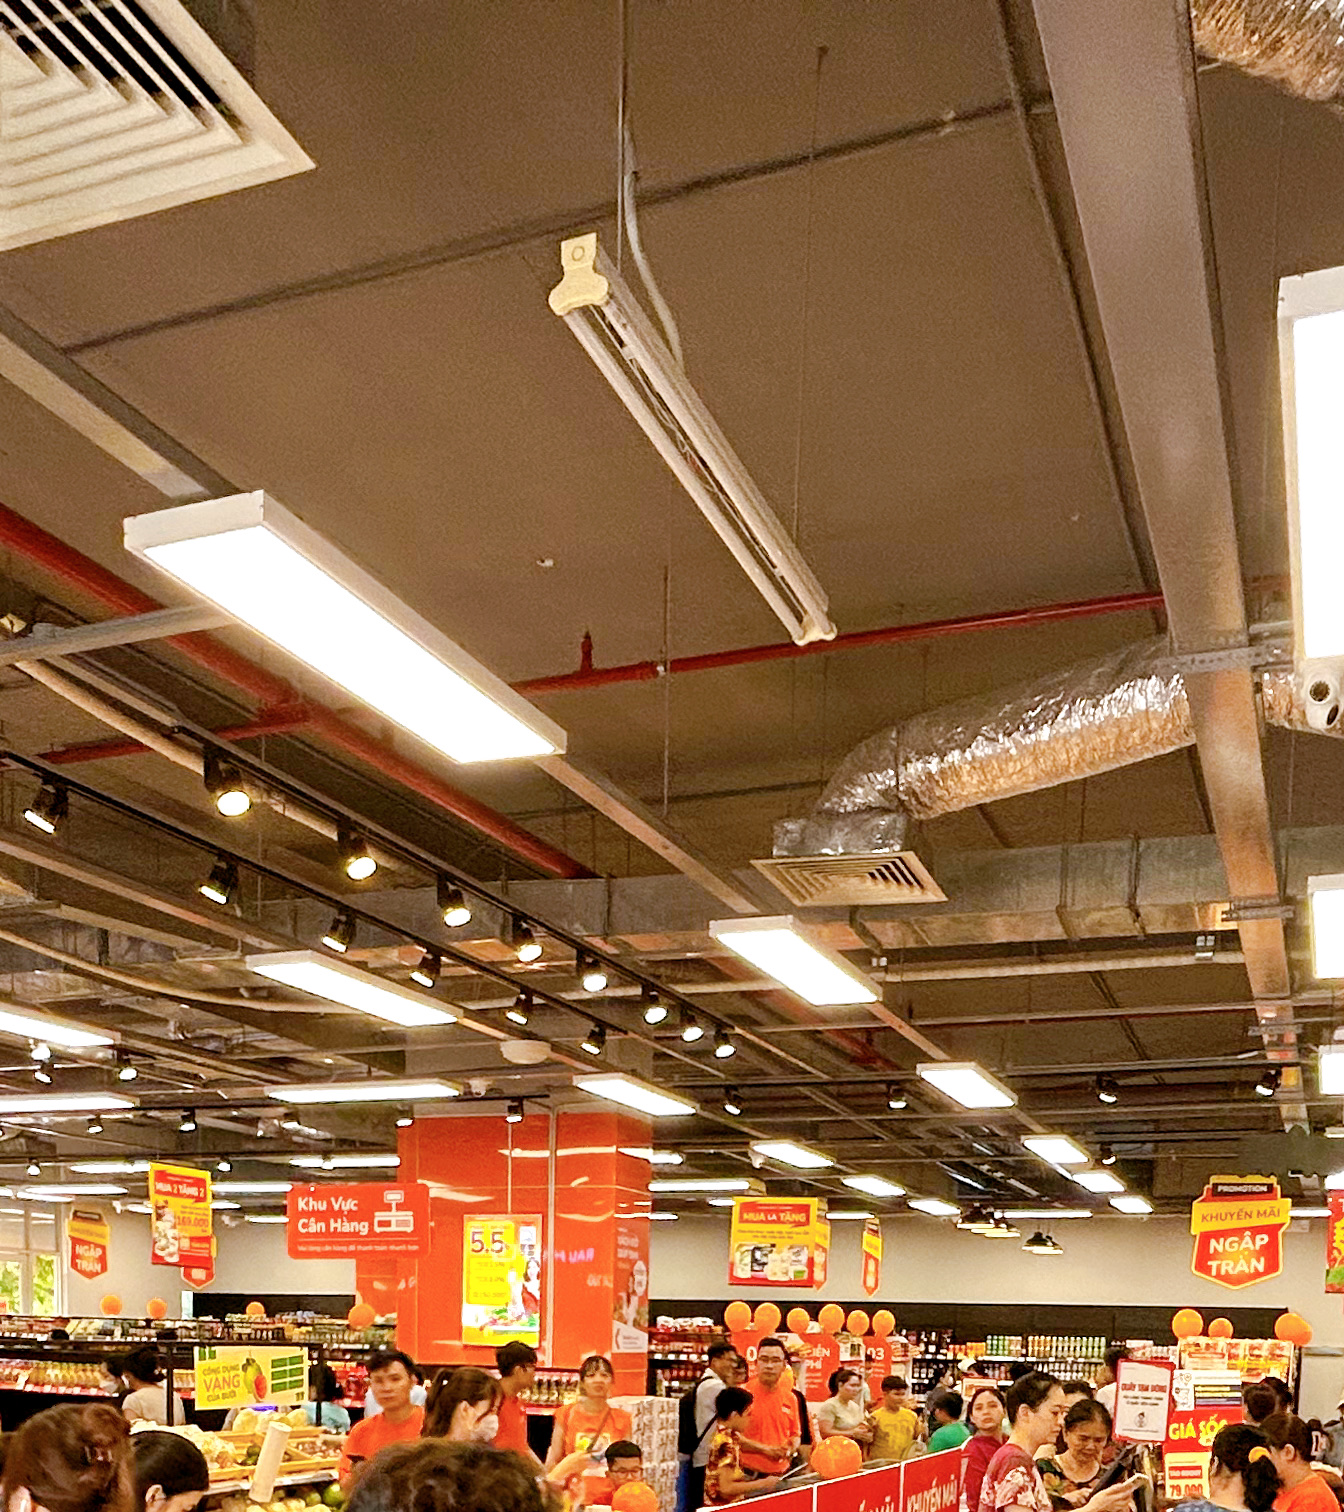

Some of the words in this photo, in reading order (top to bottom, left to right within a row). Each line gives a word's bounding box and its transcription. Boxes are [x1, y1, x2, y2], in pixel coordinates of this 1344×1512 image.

[1217, 1185, 1268, 1193] PROMOTION
[297, 1197, 327, 1211] Khu
[330, 1196, 359, 1215] Vực
[1201, 1207, 1253, 1223] KHUYẾN
[1256, 1206, 1281, 1218] MÃI
[297, 1217, 326, 1233] Cân
[330, 1216, 369, 1236] Hàng
[1209, 1230, 1269, 1255] NGẬP
[1207, 1255, 1265, 1277] TRÀN
[1168, 1417, 1197, 1441] GIÁ
